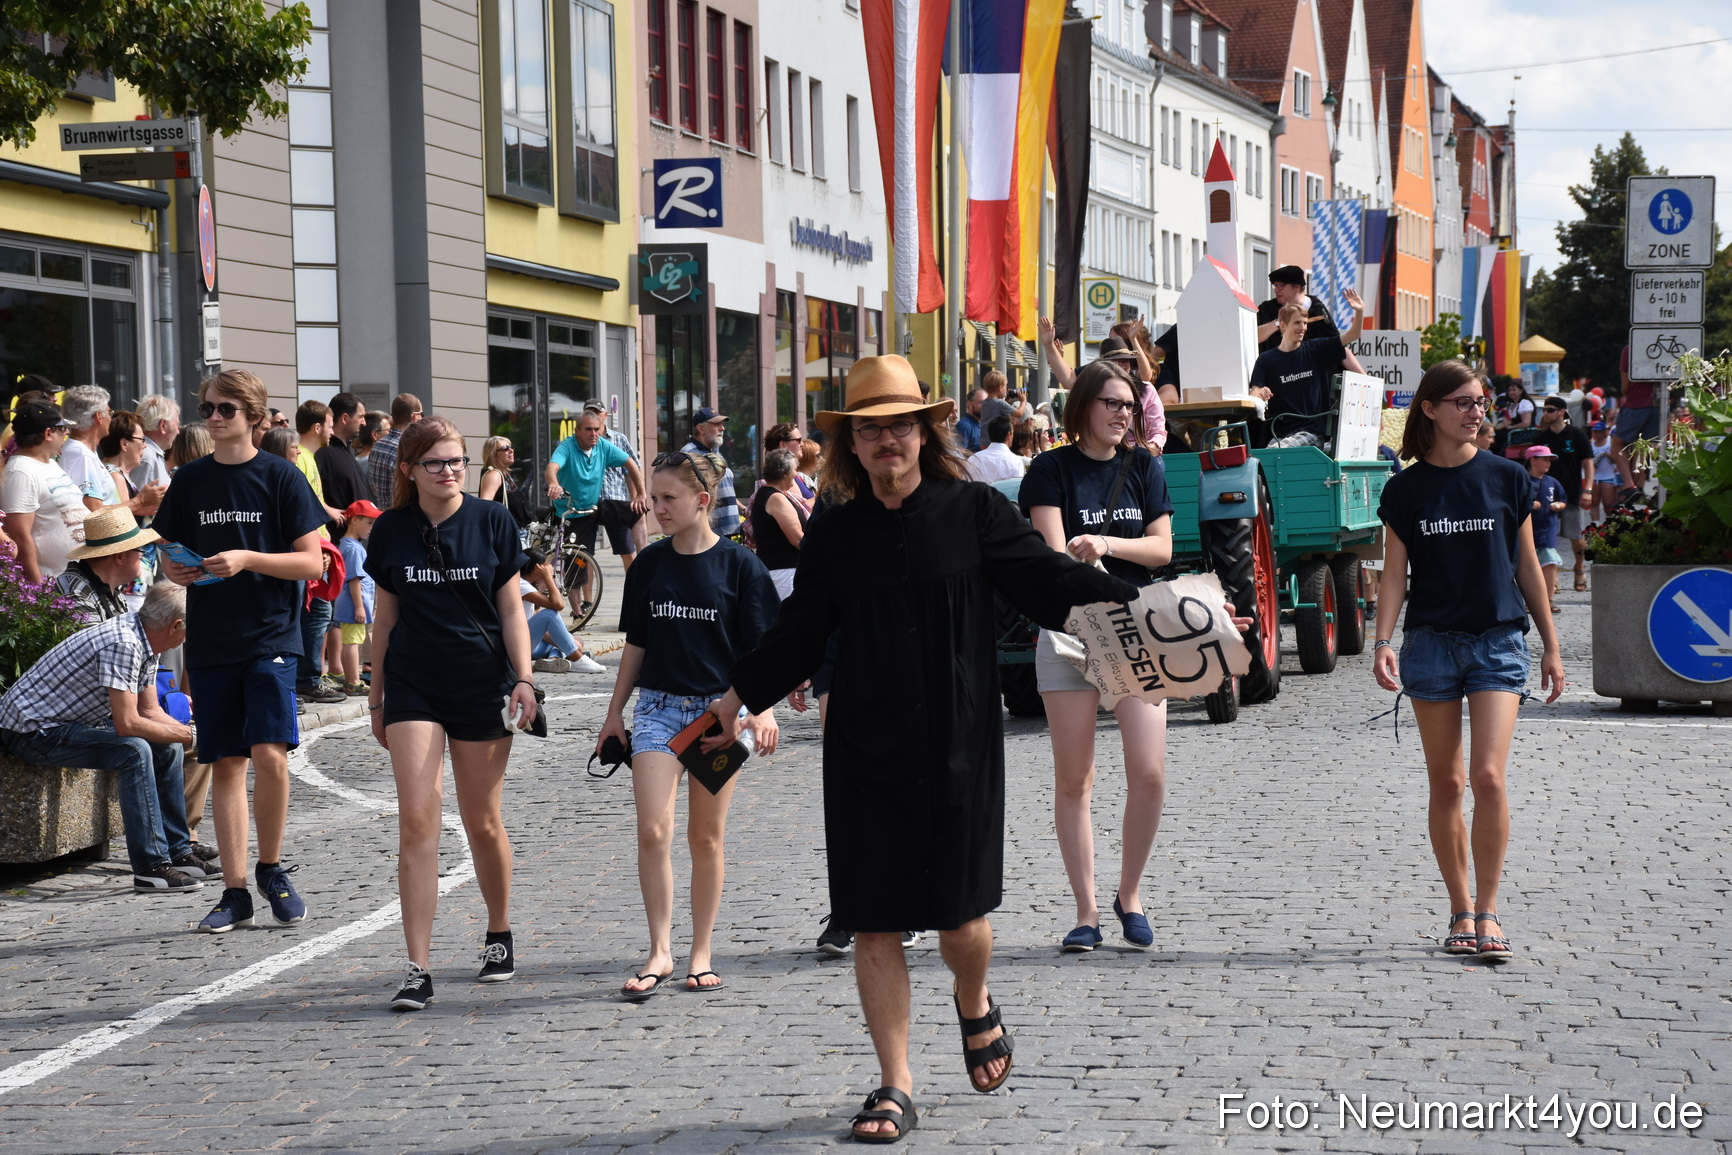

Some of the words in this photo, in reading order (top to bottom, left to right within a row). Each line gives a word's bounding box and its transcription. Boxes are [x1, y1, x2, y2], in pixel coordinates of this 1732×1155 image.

[64, 126, 184, 145] Brunnwirtsgasse
[97, 168, 137, 178] Bürgerhaus
[1648, 244, 1691, 258] ZONE
[659, 262, 682, 291] G2
[1636, 278, 1701, 290] Lieferverkehr
[1680, 292, 1687, 304] h
[1659, 306, 1676, 318] frei
[1375, 336, 1408, 357] Kirch
[1279, 369, 1313, 384] Lutheraner
[198, 508, 262, 526] Lutheraner
[1419, 517, 1495, 536] Lutheraner
[404, 565, 479, 585] Luthraner
[649, 600, 718, 622] Lutheraner
[1105, 601, 1166, 692] THESEN
[1145, 596, 1230, 683] 95
[1097, 634, 1110, 649] die
[1104, 652, 1130, 696] Erlösung
[1088, 658, 1109, 695] Glauben
